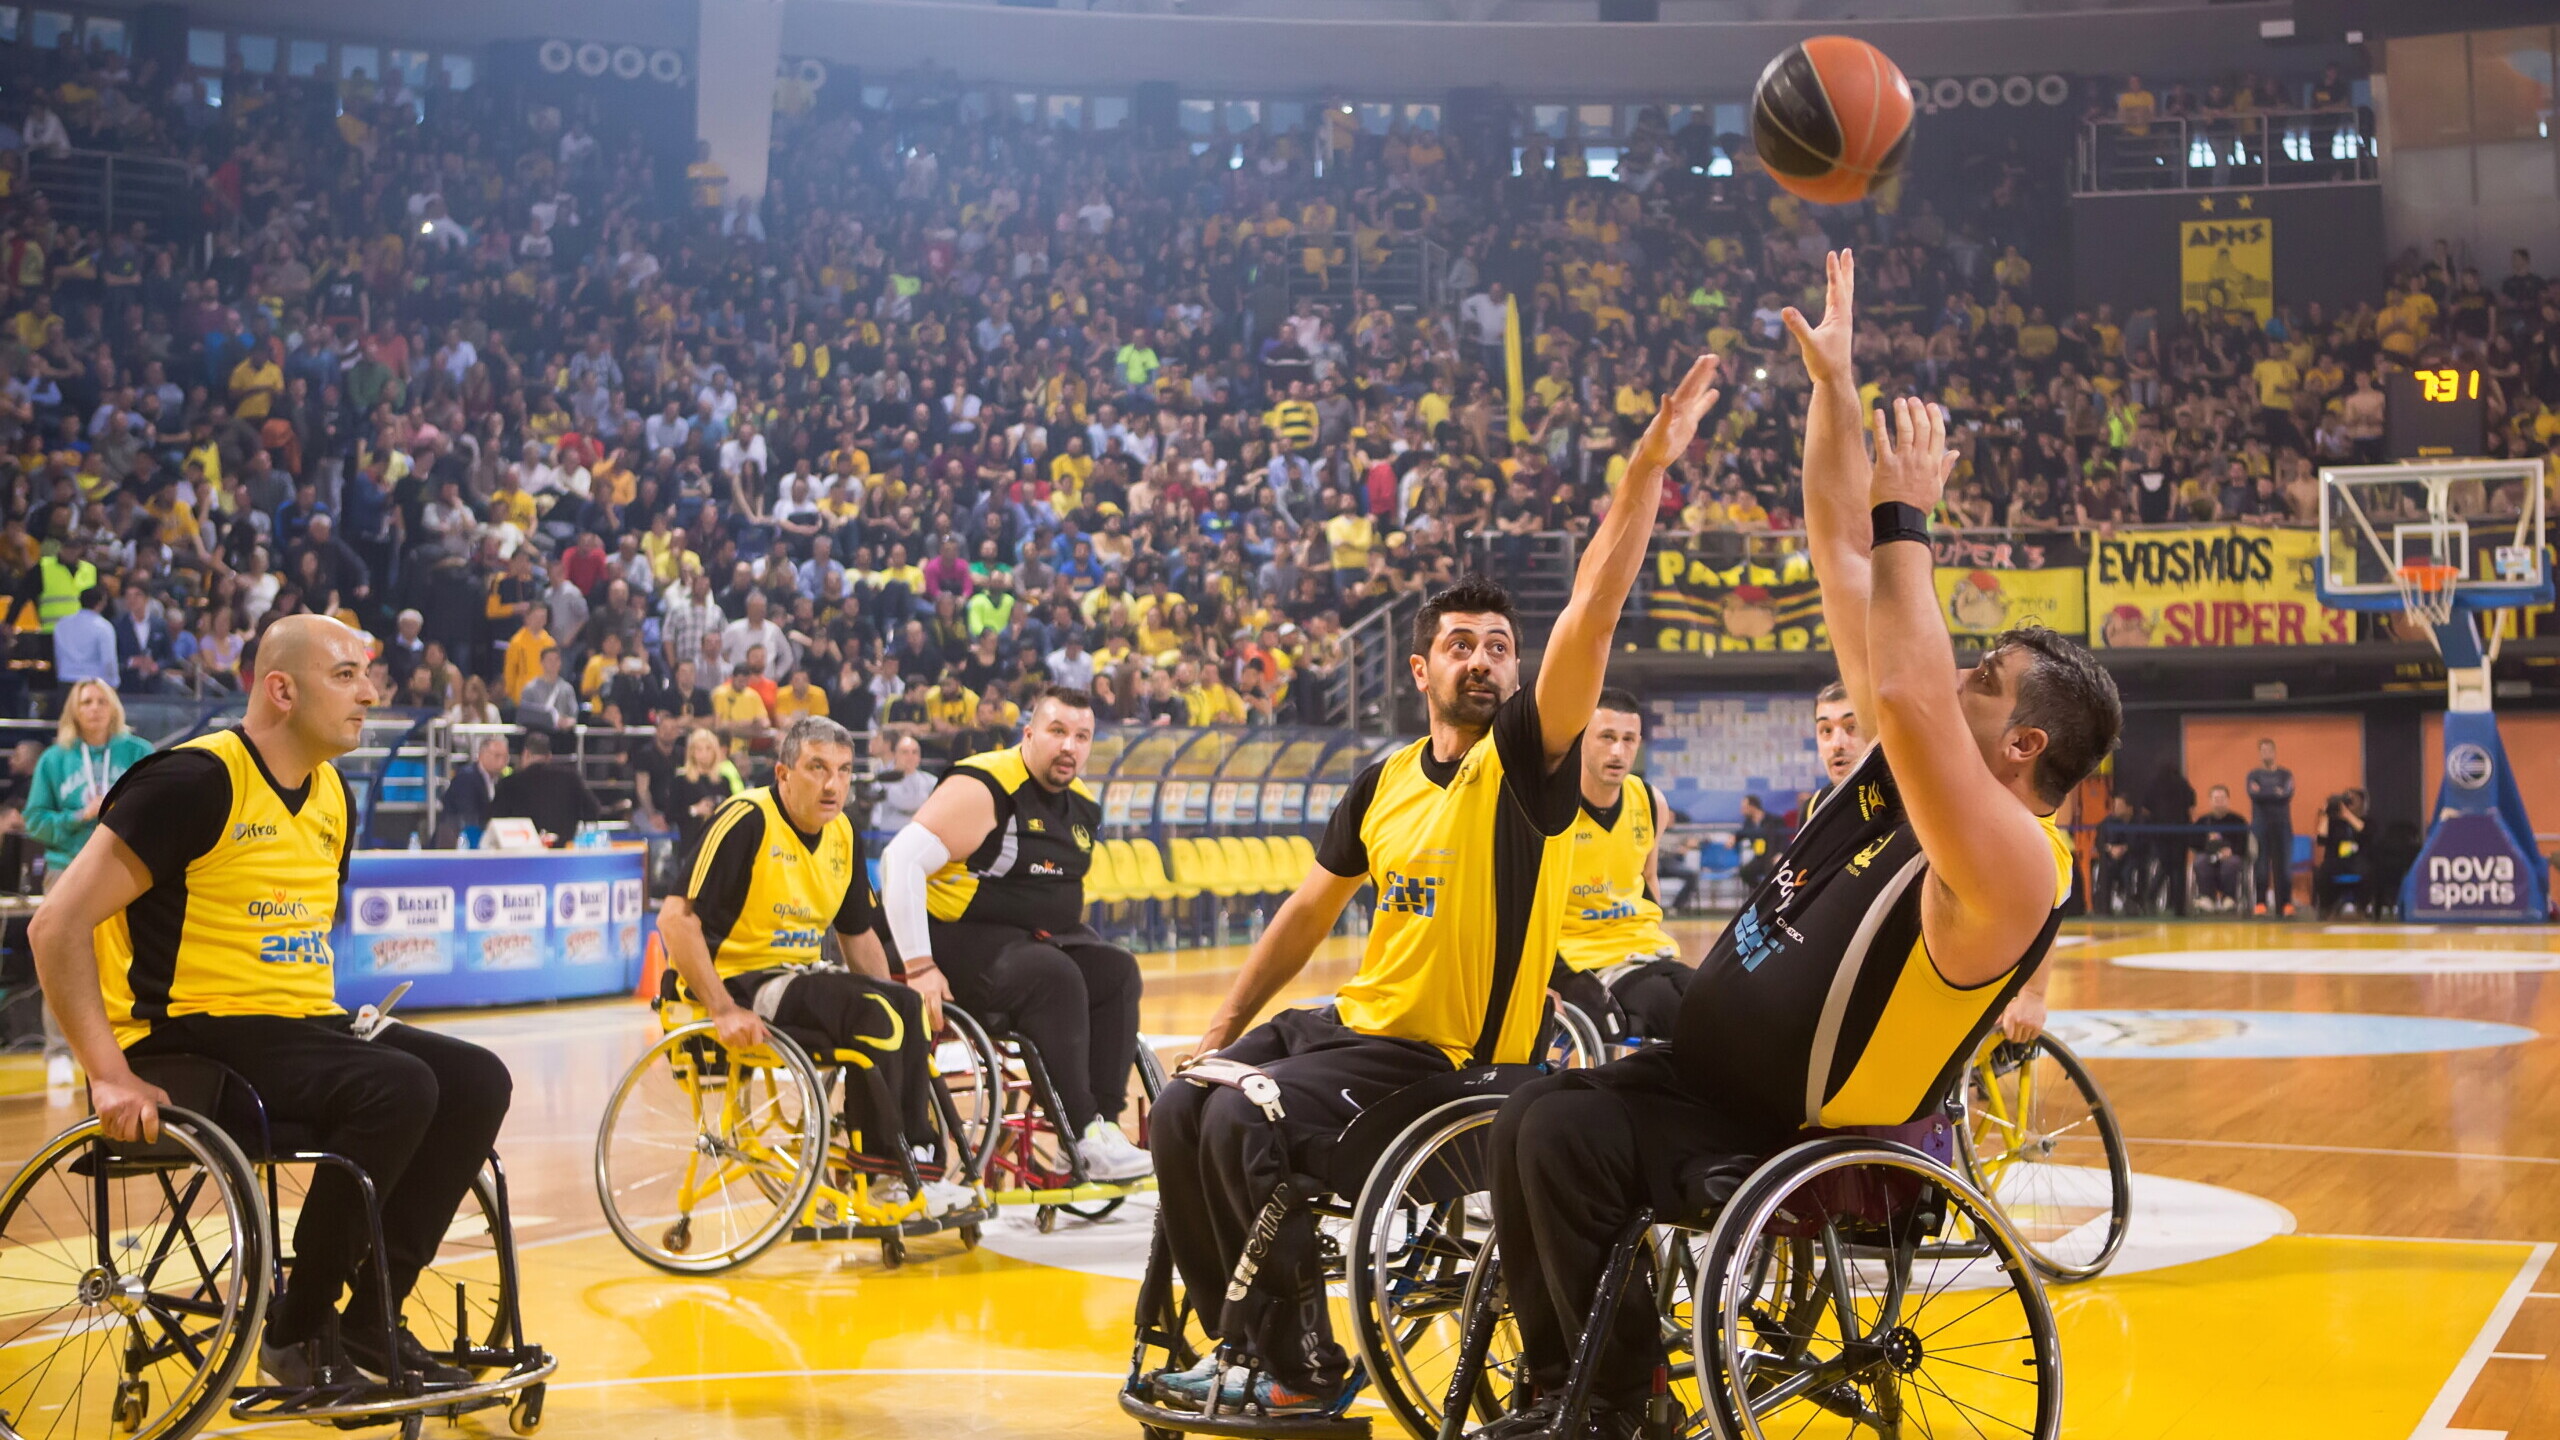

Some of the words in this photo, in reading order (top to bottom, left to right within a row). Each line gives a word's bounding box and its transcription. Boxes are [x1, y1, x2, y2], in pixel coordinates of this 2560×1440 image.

[1934, 540, 2017, 569] UPER
[2099, 536, 2273, 592] EVOSMOS
[2164, 601, 2307, 647] SUPER
[2429, 855, 2514, 882] nova
[2429, 880, 2516, 911] sports
